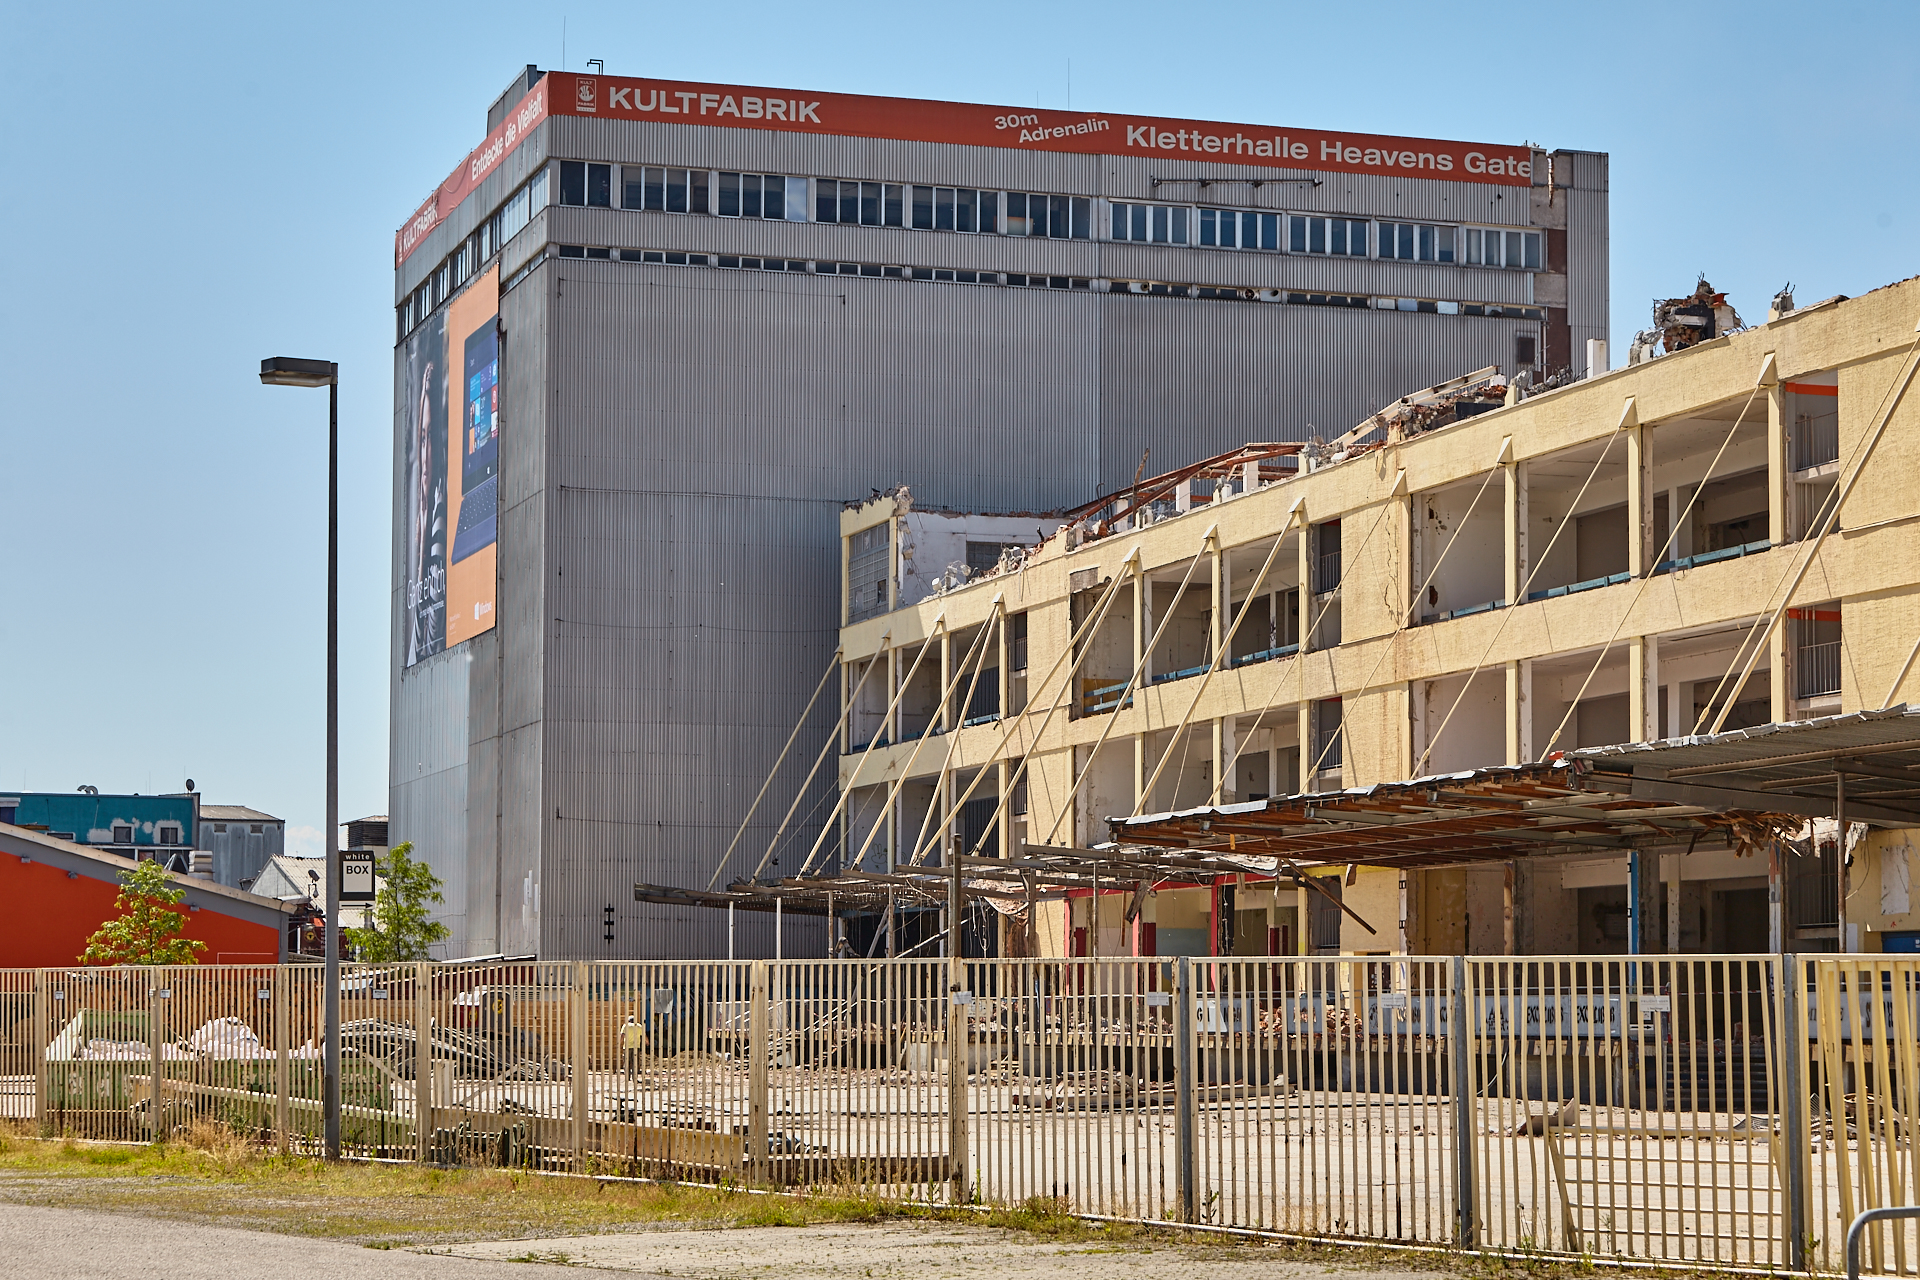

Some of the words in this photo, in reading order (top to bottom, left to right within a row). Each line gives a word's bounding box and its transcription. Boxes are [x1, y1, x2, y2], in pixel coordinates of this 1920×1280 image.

[609, 86, 821, 124] KULTFABRIK
[471, 136, 504, 181] Entdecke
[504, 122, 516, 148] die
[517, 91, 543, 134] Vielfalt
[994, 114, 1039, 130] 30m
[1018, 118, 1110, 143] Adrenalin
[1126, 125, 1309, 160] Kletterhalle
[1320, 140, 1454, 171] Heavens
[1463, 152, 1531, 178] Gate
[346, 865, 369, 875] BOX
